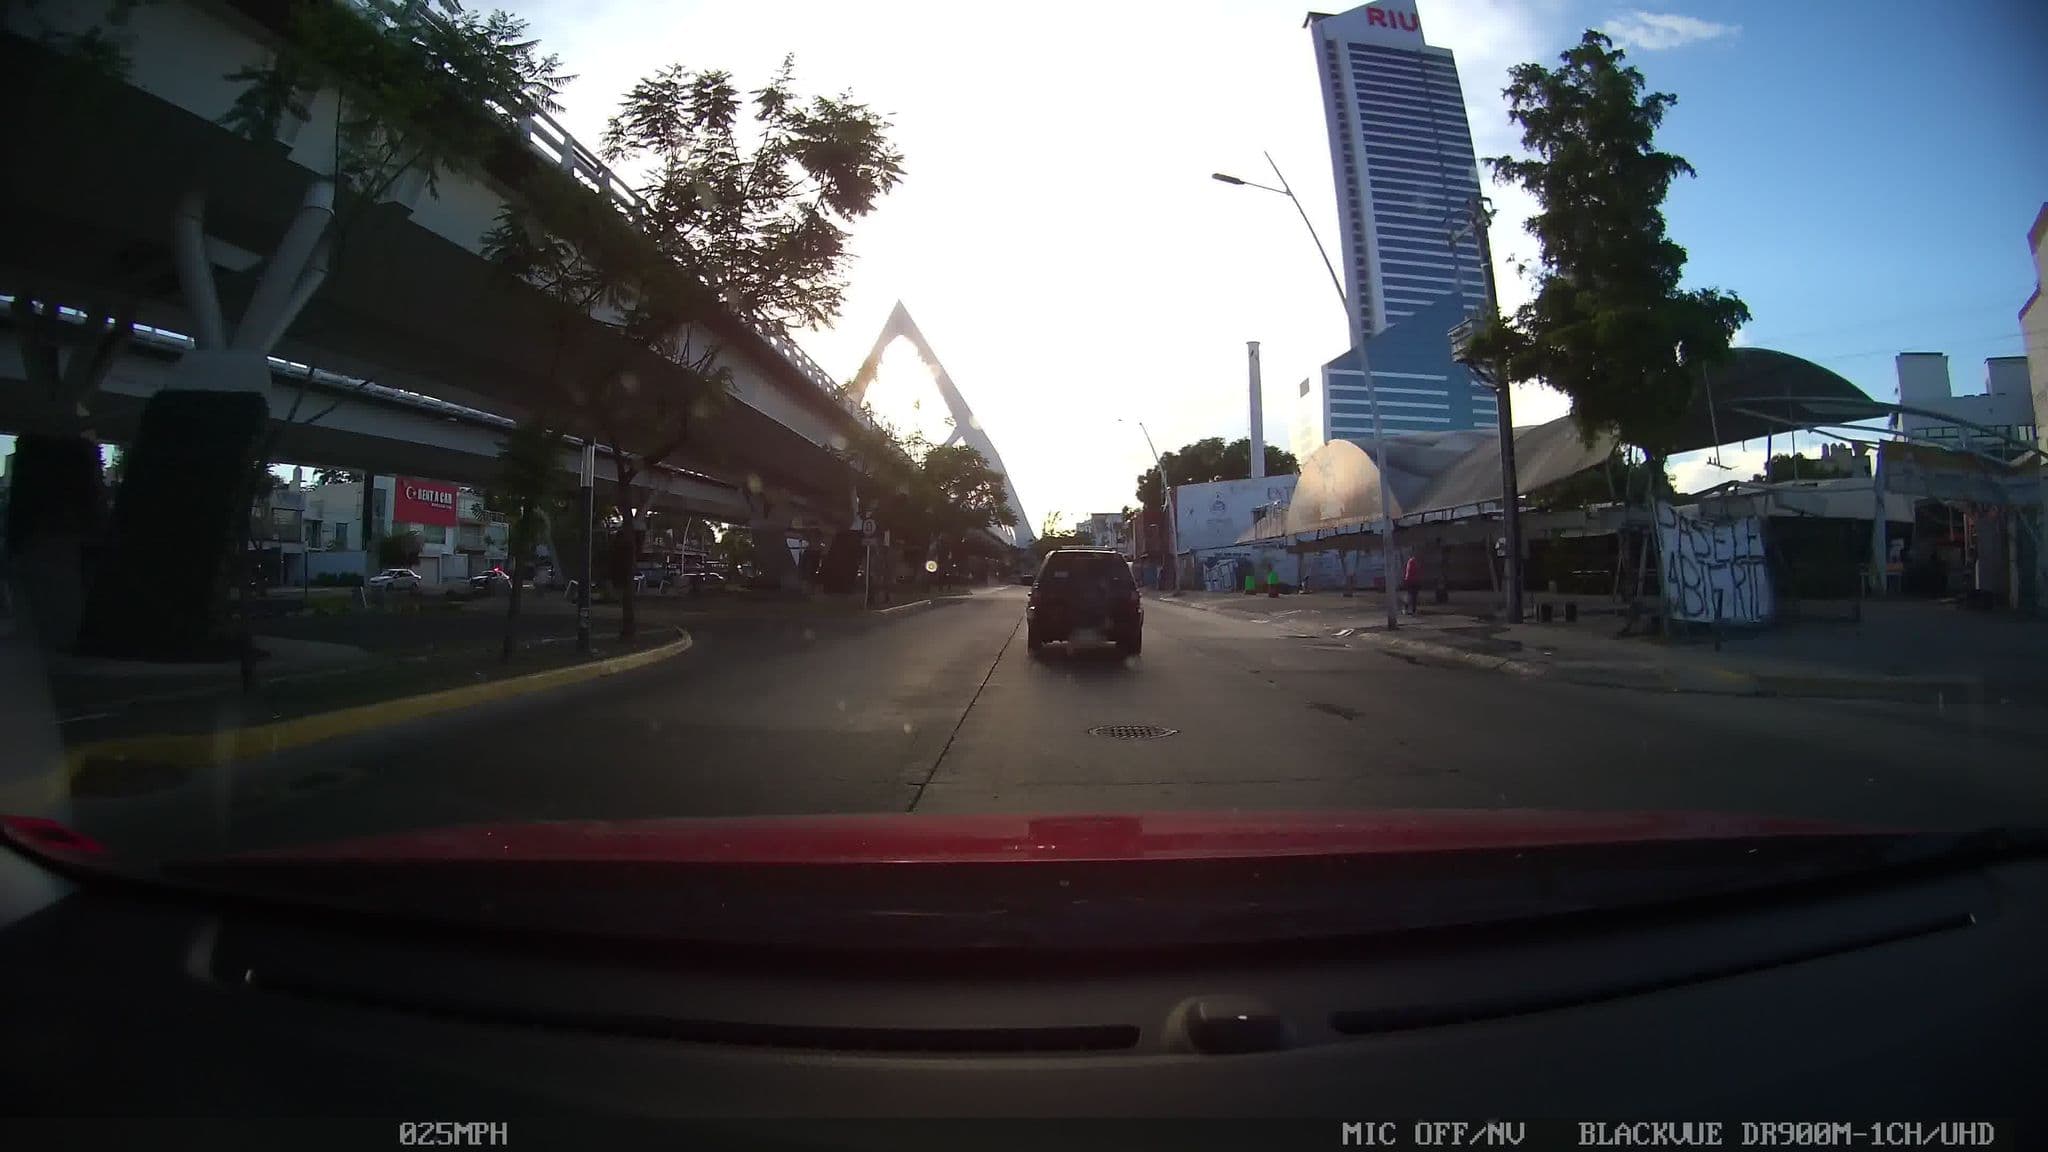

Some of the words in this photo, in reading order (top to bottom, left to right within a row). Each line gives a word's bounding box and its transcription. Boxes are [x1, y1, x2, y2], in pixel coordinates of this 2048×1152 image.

[1367, 7, 1419, 32] RIU
[418, 489, 434, 502] RENT
[441, 492, 453, 504] CAR
